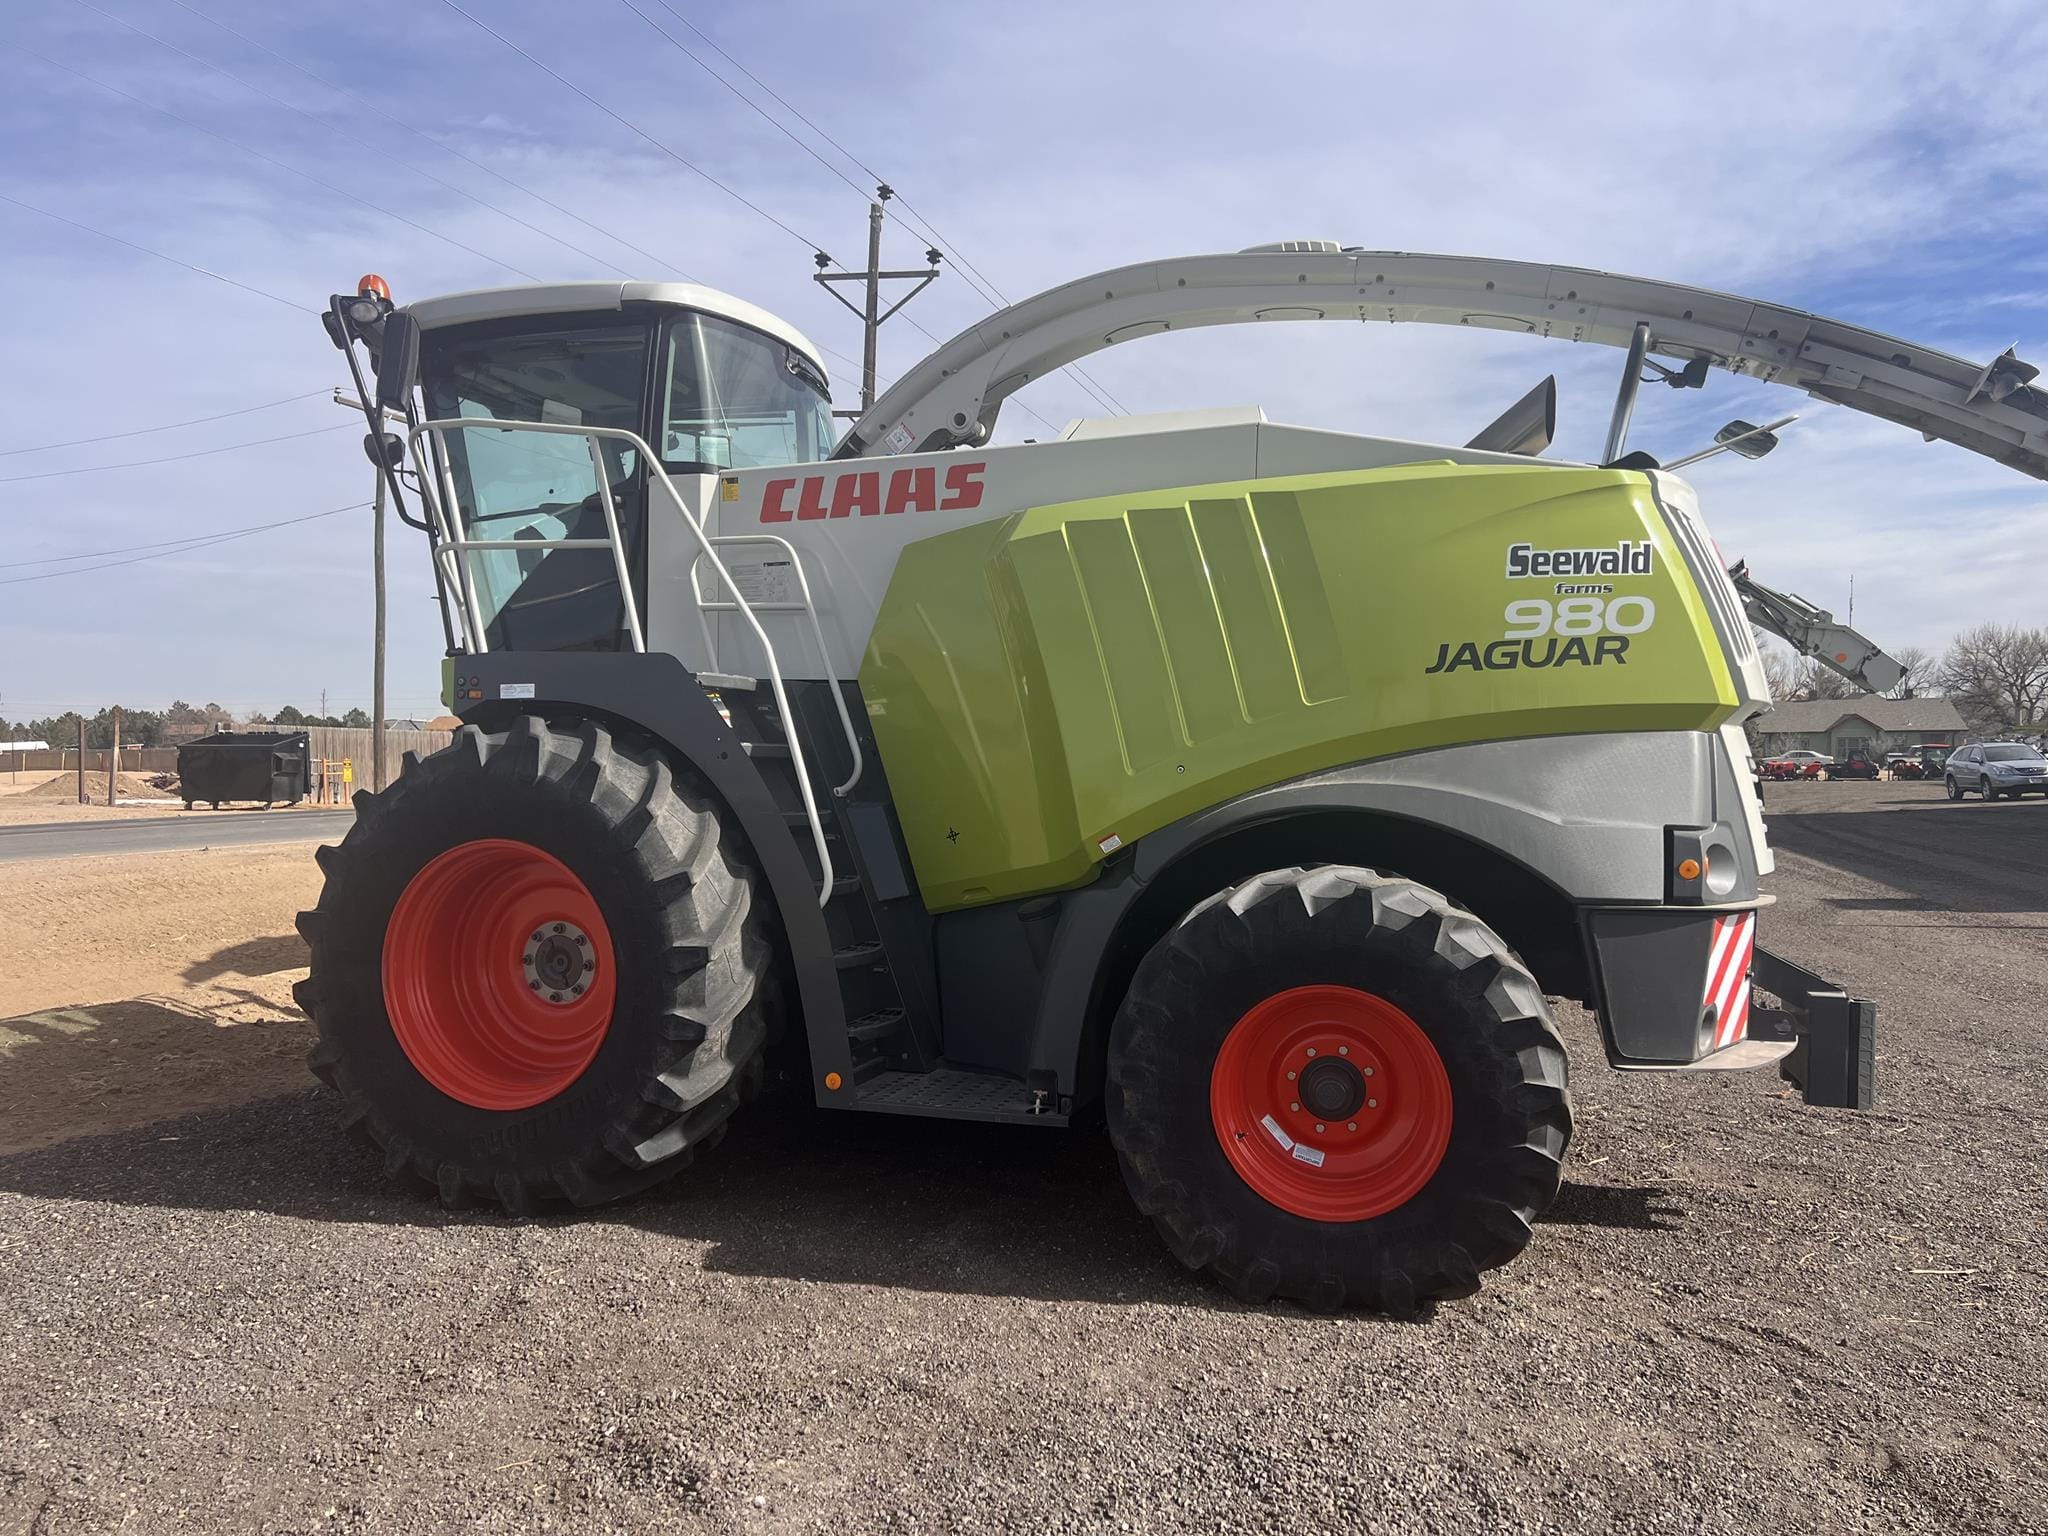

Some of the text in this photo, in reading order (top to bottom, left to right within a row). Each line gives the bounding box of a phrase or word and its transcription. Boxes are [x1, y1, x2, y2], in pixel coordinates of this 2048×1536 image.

[759, 462, 987, 524] CLAAS
[1507, 541, 1652, 578] Seewald
[1555, 582, 1613, 595] farms
[1503, 596, 1656, 639] 980
[1425, 635, 1630, 674] JAGUAR
